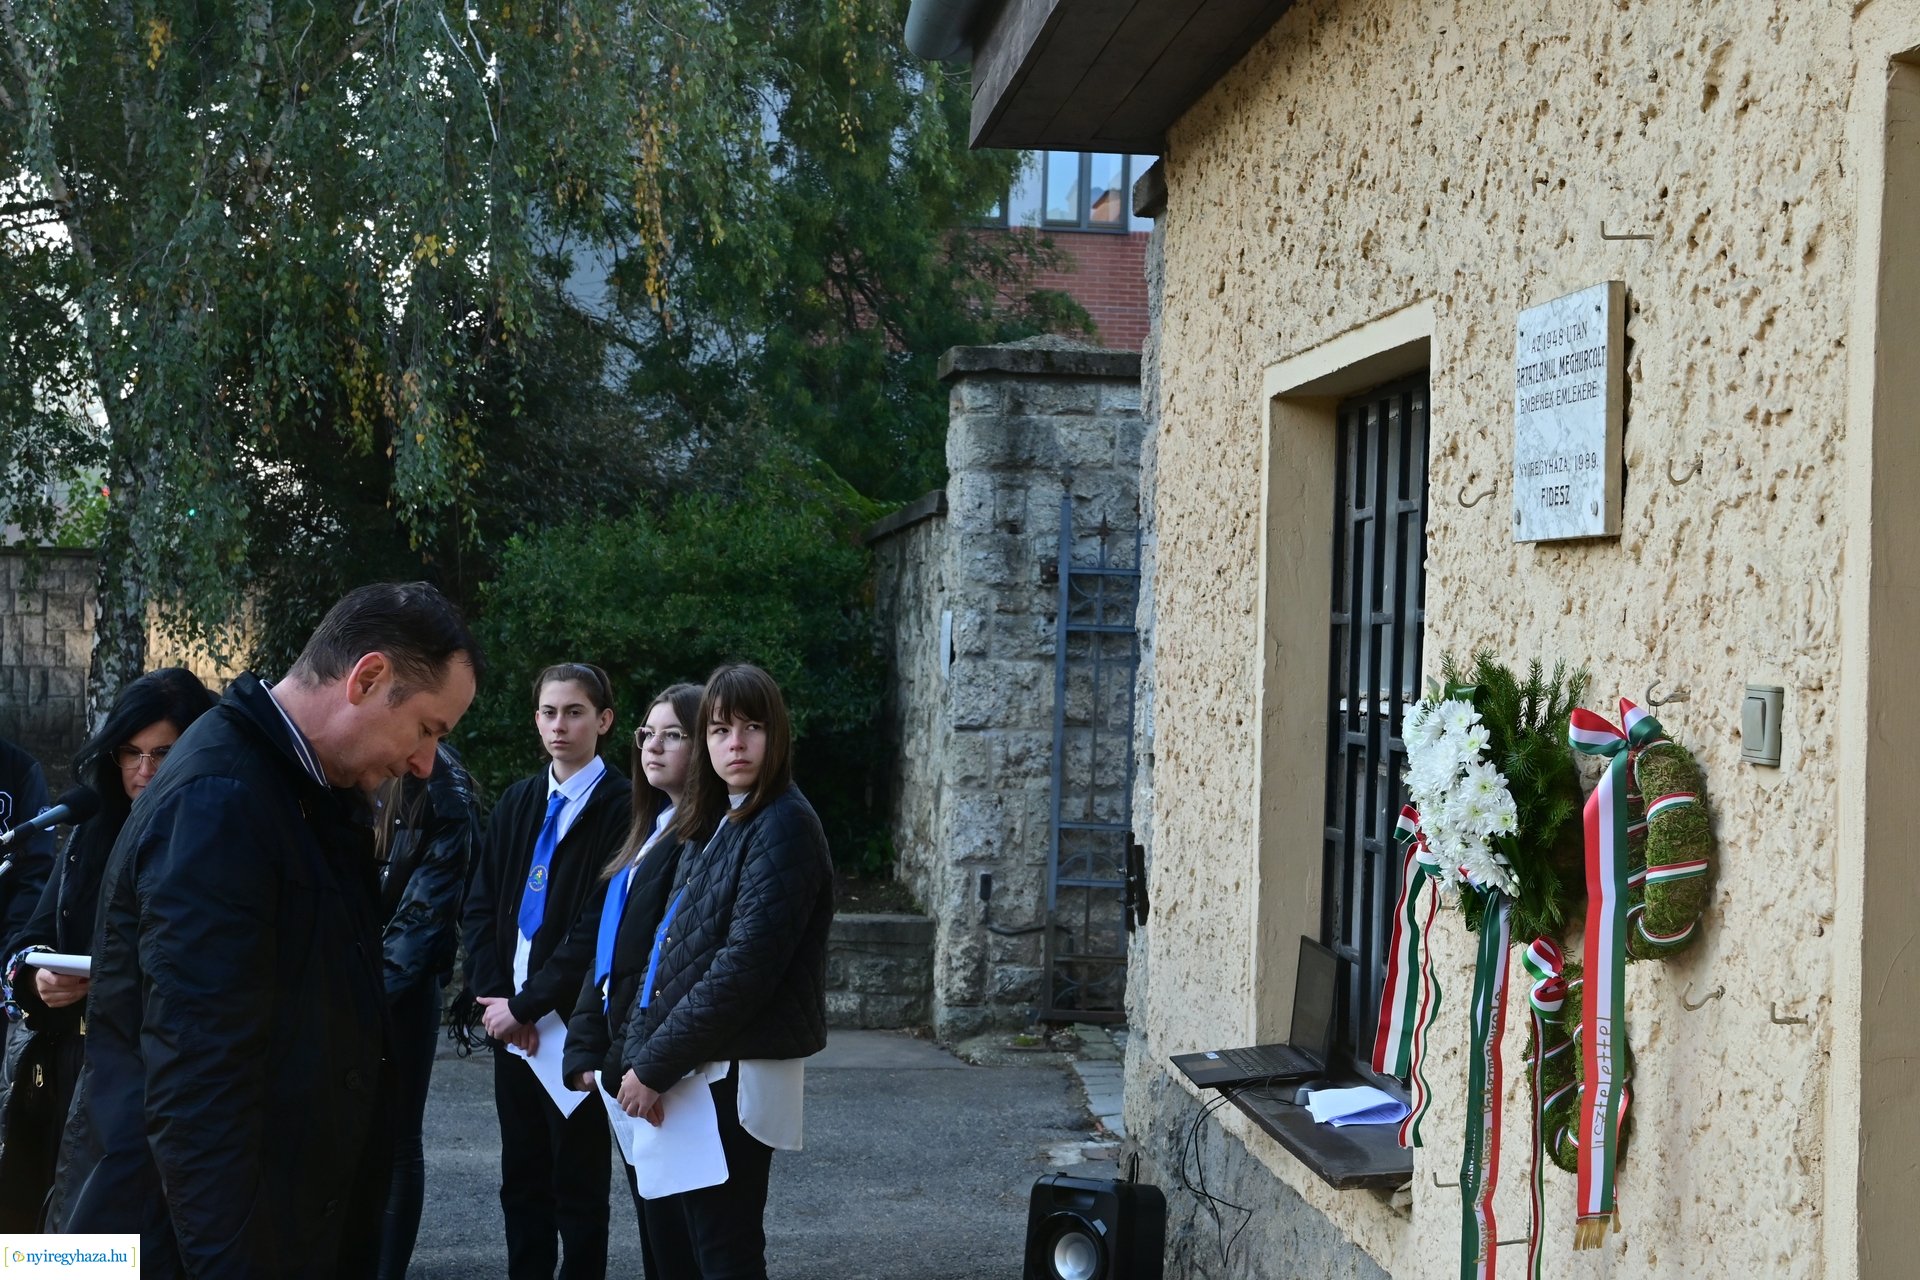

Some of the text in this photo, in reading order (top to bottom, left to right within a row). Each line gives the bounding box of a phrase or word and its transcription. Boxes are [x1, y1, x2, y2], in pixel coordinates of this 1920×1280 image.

[1531, 334, 1542, 353] AZ
[1543, 328, 1564, 350] 1948
[1558, 345, 1606, 377] MEGHURCOLT
[1520, 391, 1554, 414] EMBEREK
[1541, 485, 1570, 508] FIDESZ
